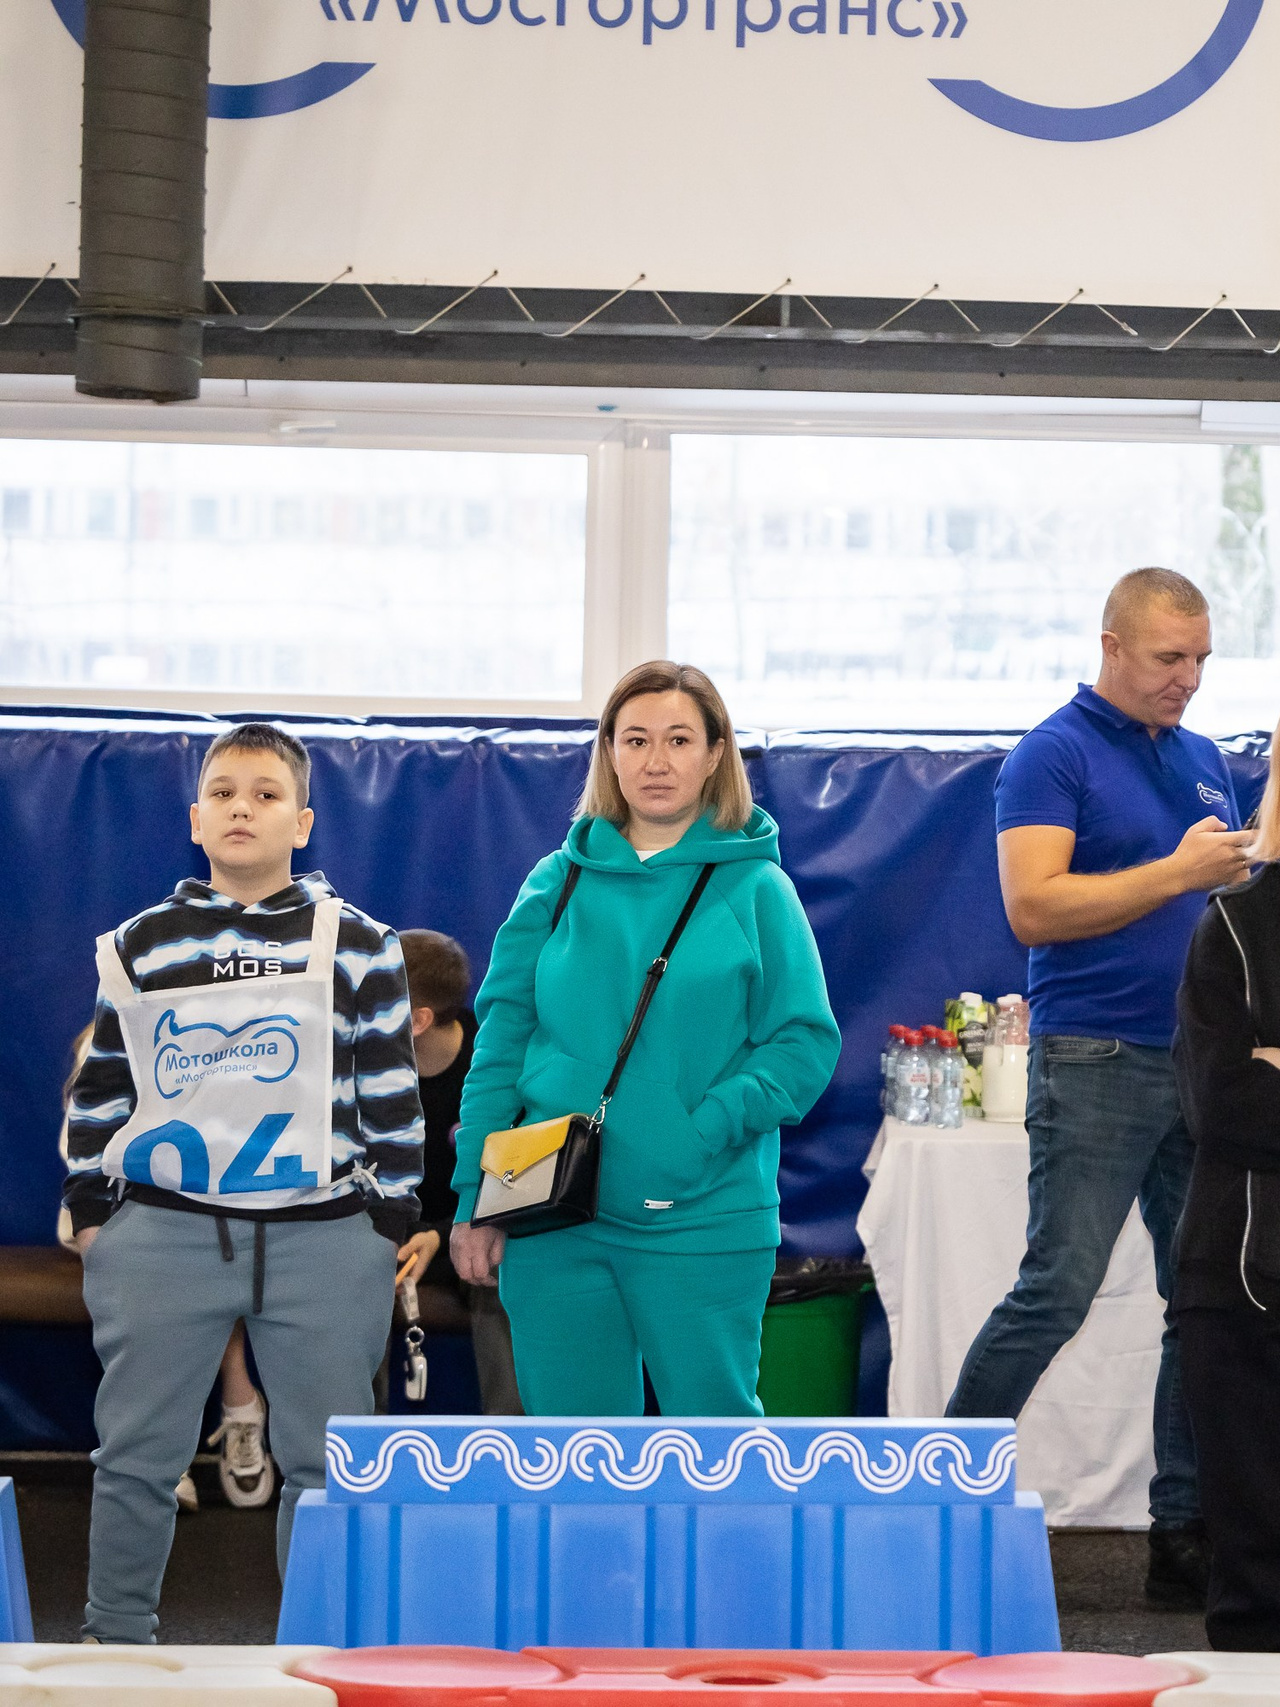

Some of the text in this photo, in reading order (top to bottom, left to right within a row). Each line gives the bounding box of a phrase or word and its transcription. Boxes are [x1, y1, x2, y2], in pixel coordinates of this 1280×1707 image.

[213, 959, 283, 978] MOS
[165, 1041, 279, 1073] Мотошкола
[174, 1062, 259, 1085] «Мосгортранс»
[122, 1112, 319, 1195] 04
